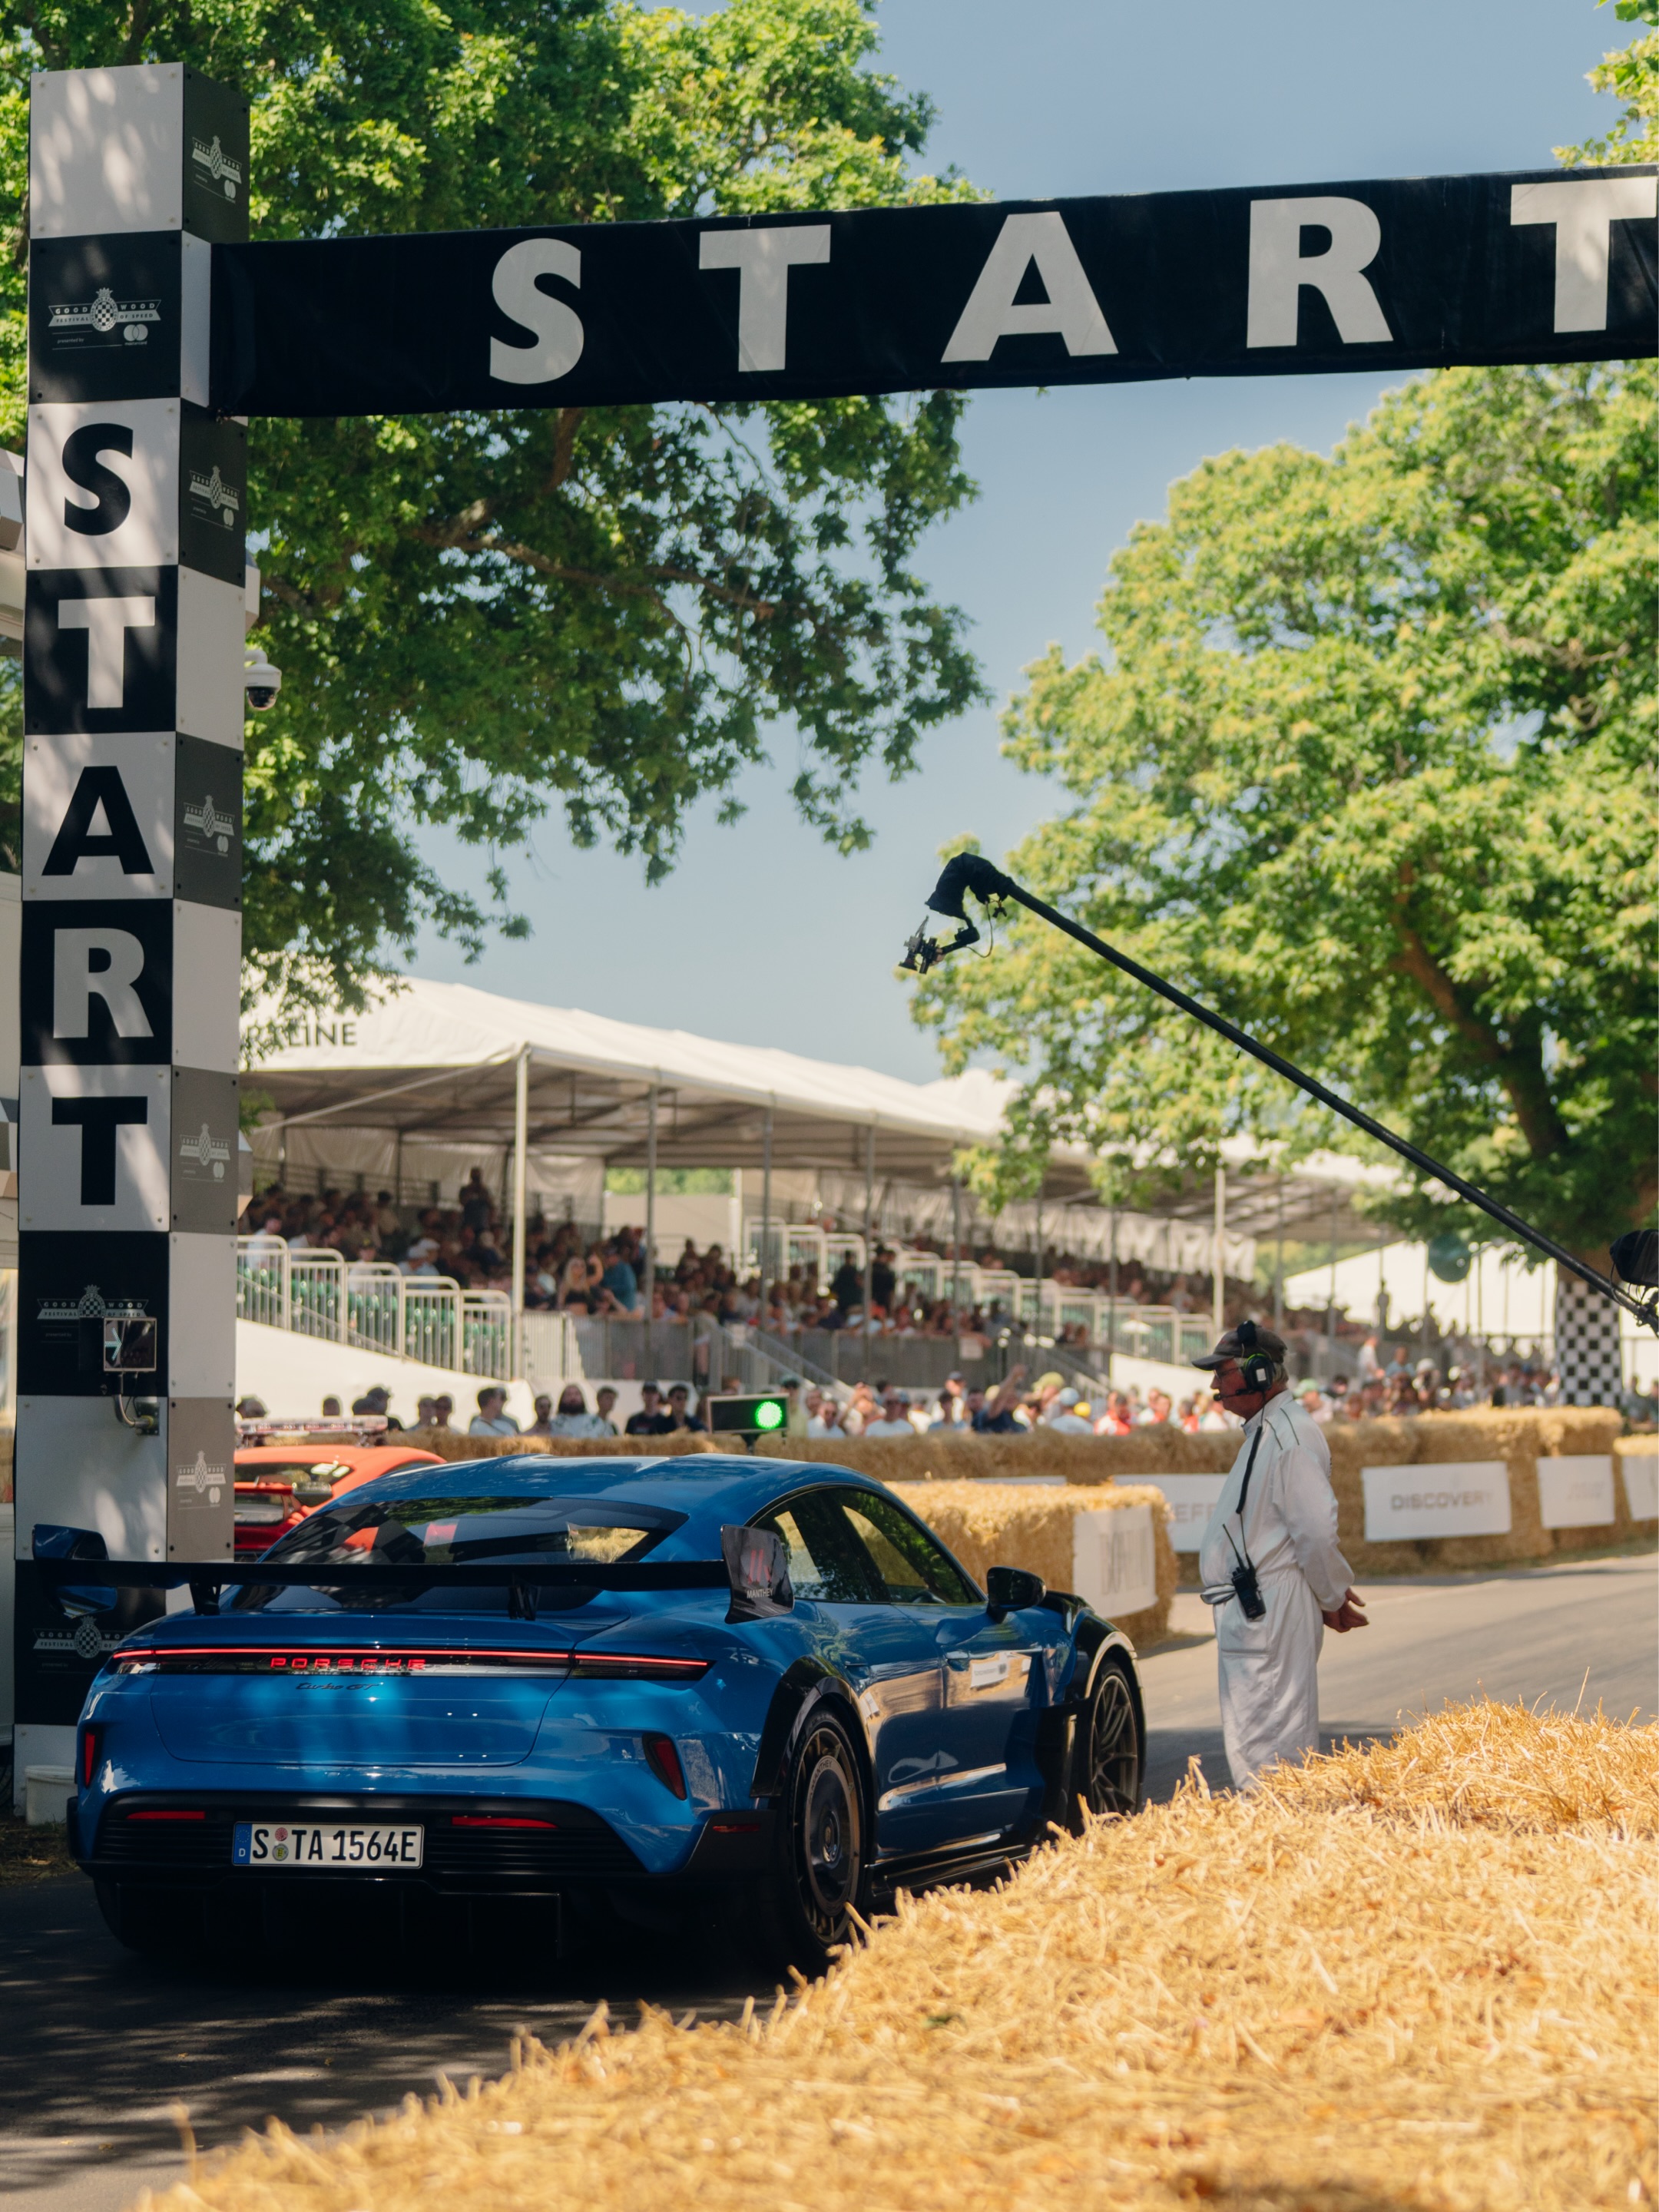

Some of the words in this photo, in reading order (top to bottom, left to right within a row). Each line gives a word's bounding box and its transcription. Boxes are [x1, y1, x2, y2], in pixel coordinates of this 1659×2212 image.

[489, 177, 1657, 384] START
[55, 306, 88, 315] GOOD
[747, 1588, 773, 1598] MANTHEY
[270, 1657, 426, 1670] PORSCHE
[253, 1829, 269, 1859] S
[238, 1848, 246, 1857] D
